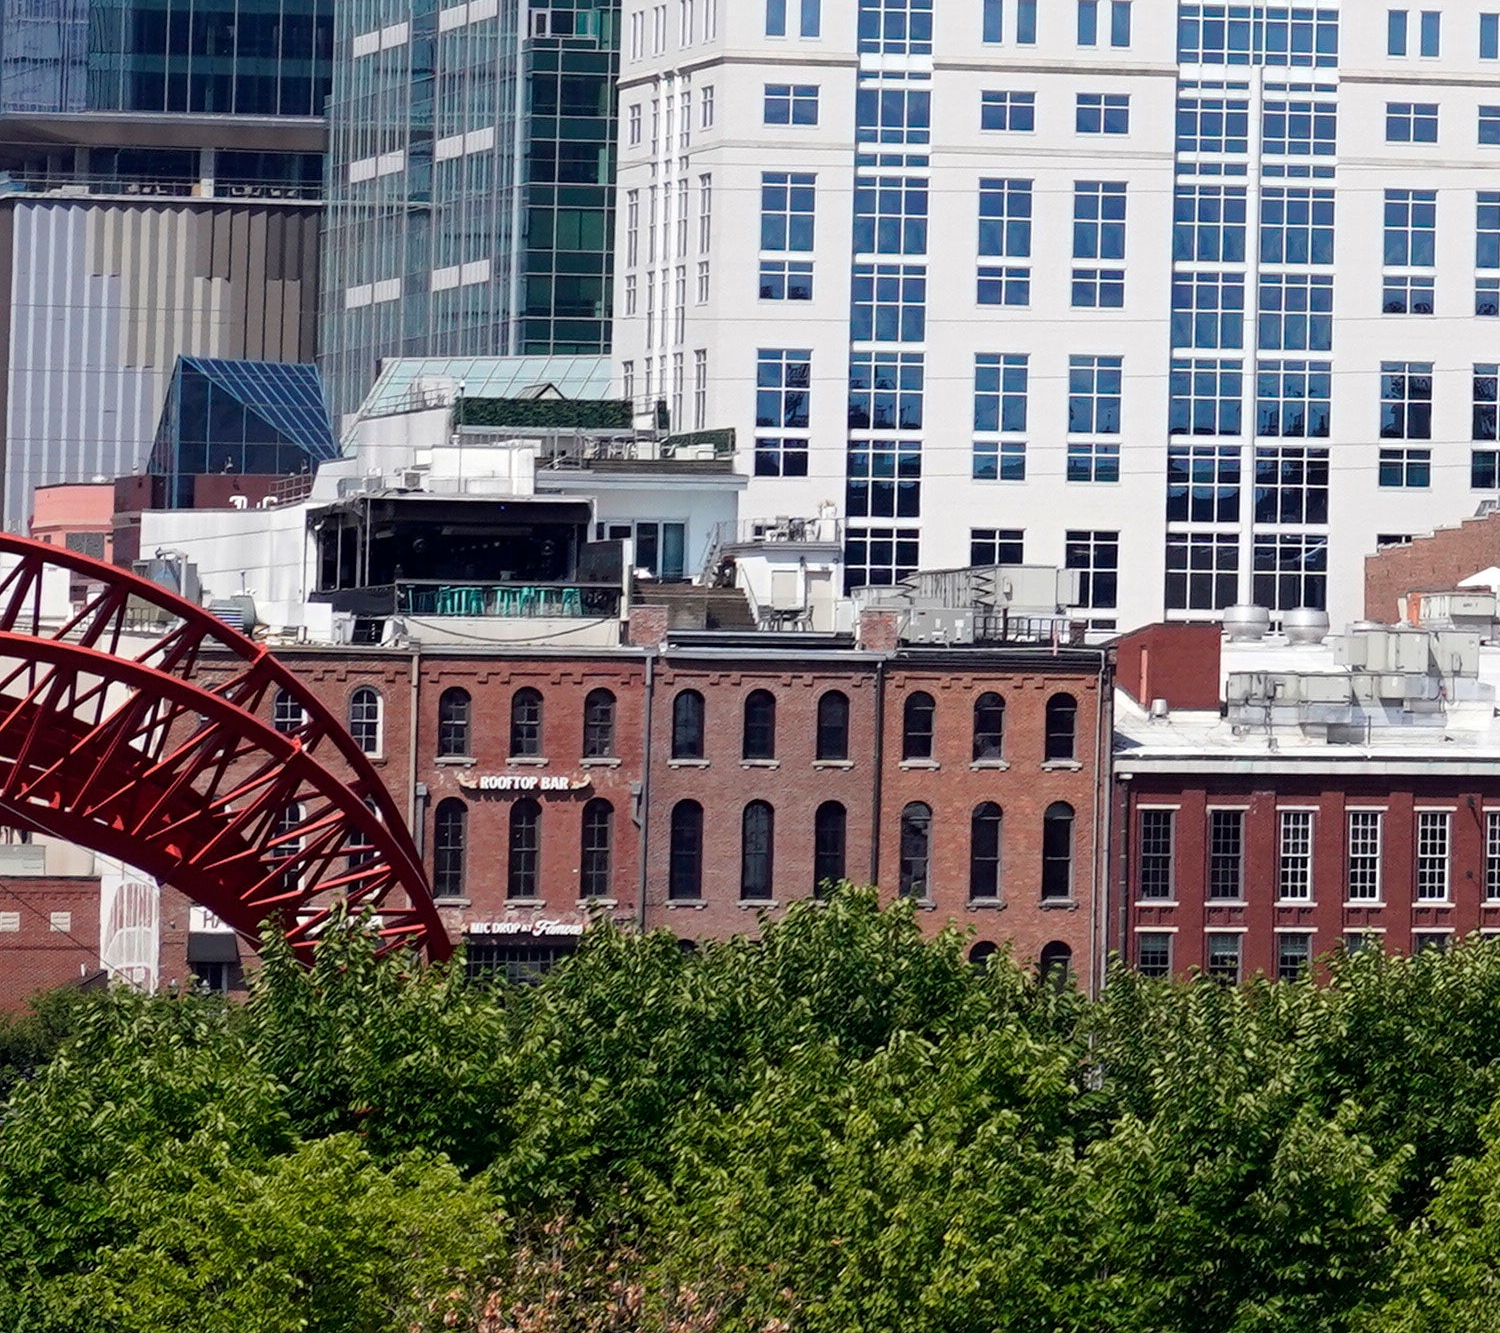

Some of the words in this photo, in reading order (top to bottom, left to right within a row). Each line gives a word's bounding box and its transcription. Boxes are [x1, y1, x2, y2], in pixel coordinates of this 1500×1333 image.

[480, 776, 538, 790] ROOFTOP
[540, 777, 569, 790] BAR
[492, 922, 521, 934] DROP
